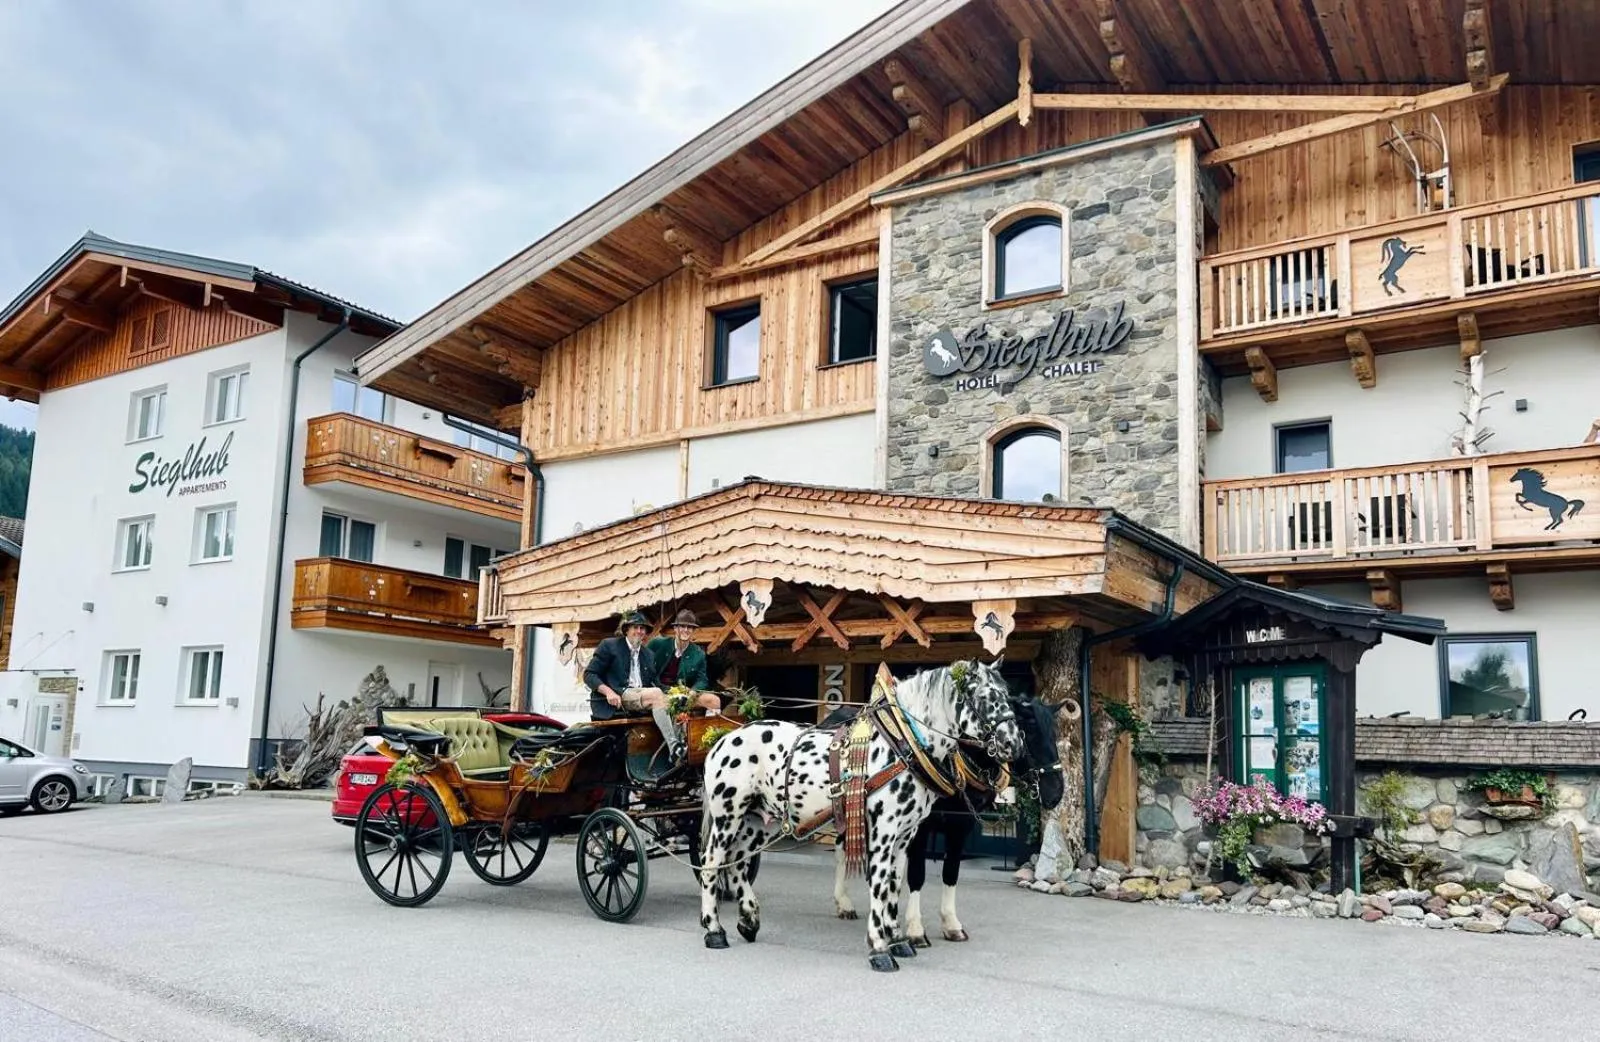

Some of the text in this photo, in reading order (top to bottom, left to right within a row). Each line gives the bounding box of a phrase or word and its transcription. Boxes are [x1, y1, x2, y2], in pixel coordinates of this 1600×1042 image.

[959, 300, 1135, 385] Sieglhub
[956, 360, 1102, 391] HOTEL CHALET
[128, 430, 234, 498] Sieglhub
[178, 480, 227, 496] APPARTEMENTS
